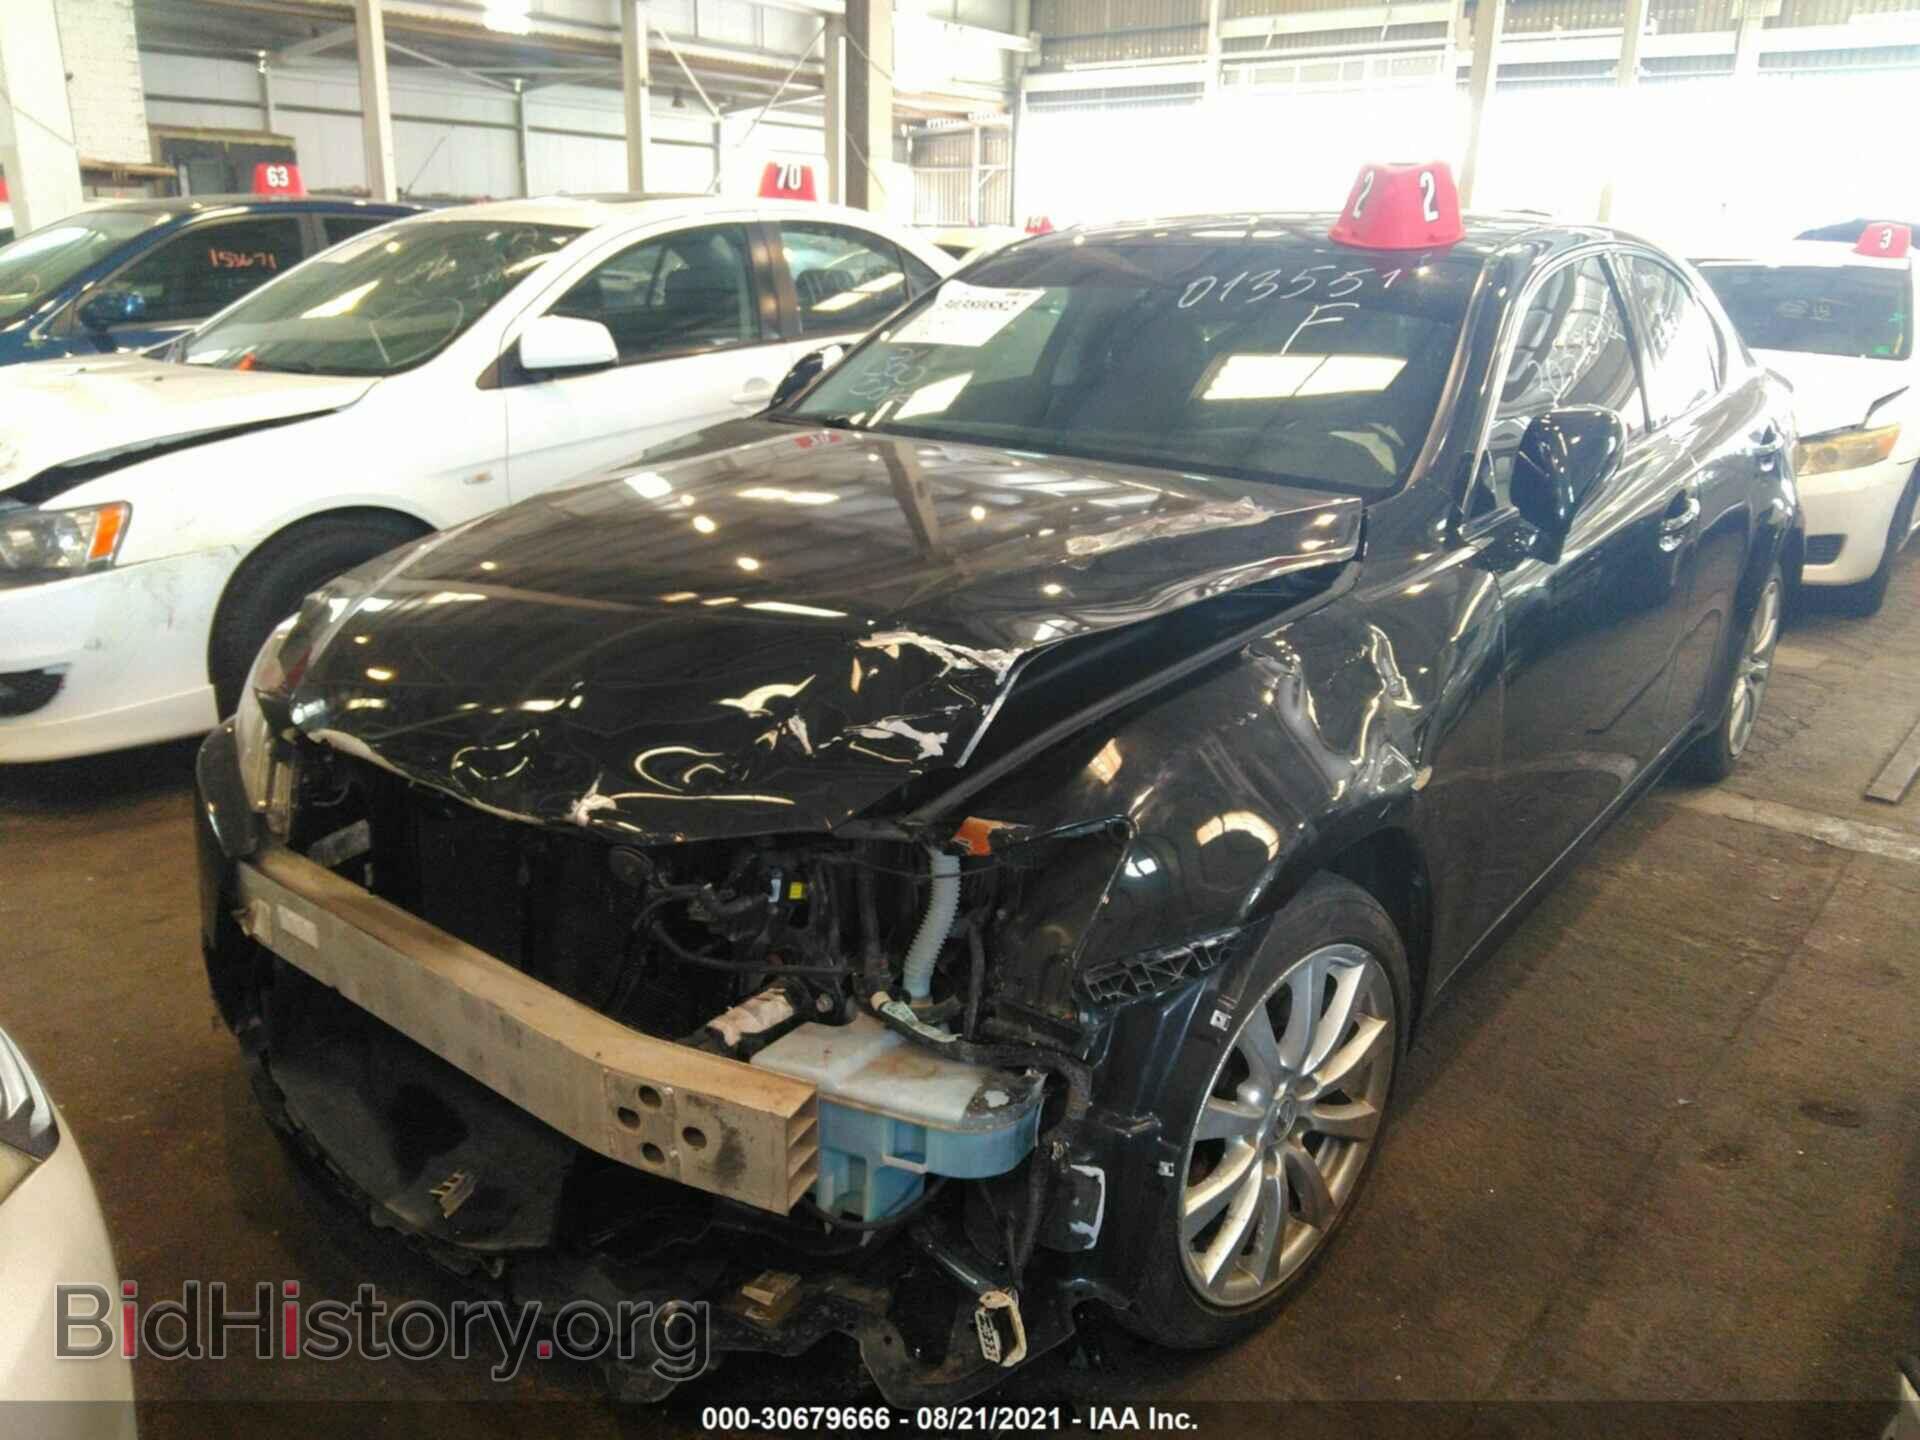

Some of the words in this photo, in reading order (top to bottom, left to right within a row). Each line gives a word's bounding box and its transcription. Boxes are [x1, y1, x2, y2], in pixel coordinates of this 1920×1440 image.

[266, 164, 289, 188] 63
[776, 162, 802, 190] 70
[1420, 171, 1439, 222] 2
[1880, 227, 1892, 249] 3
